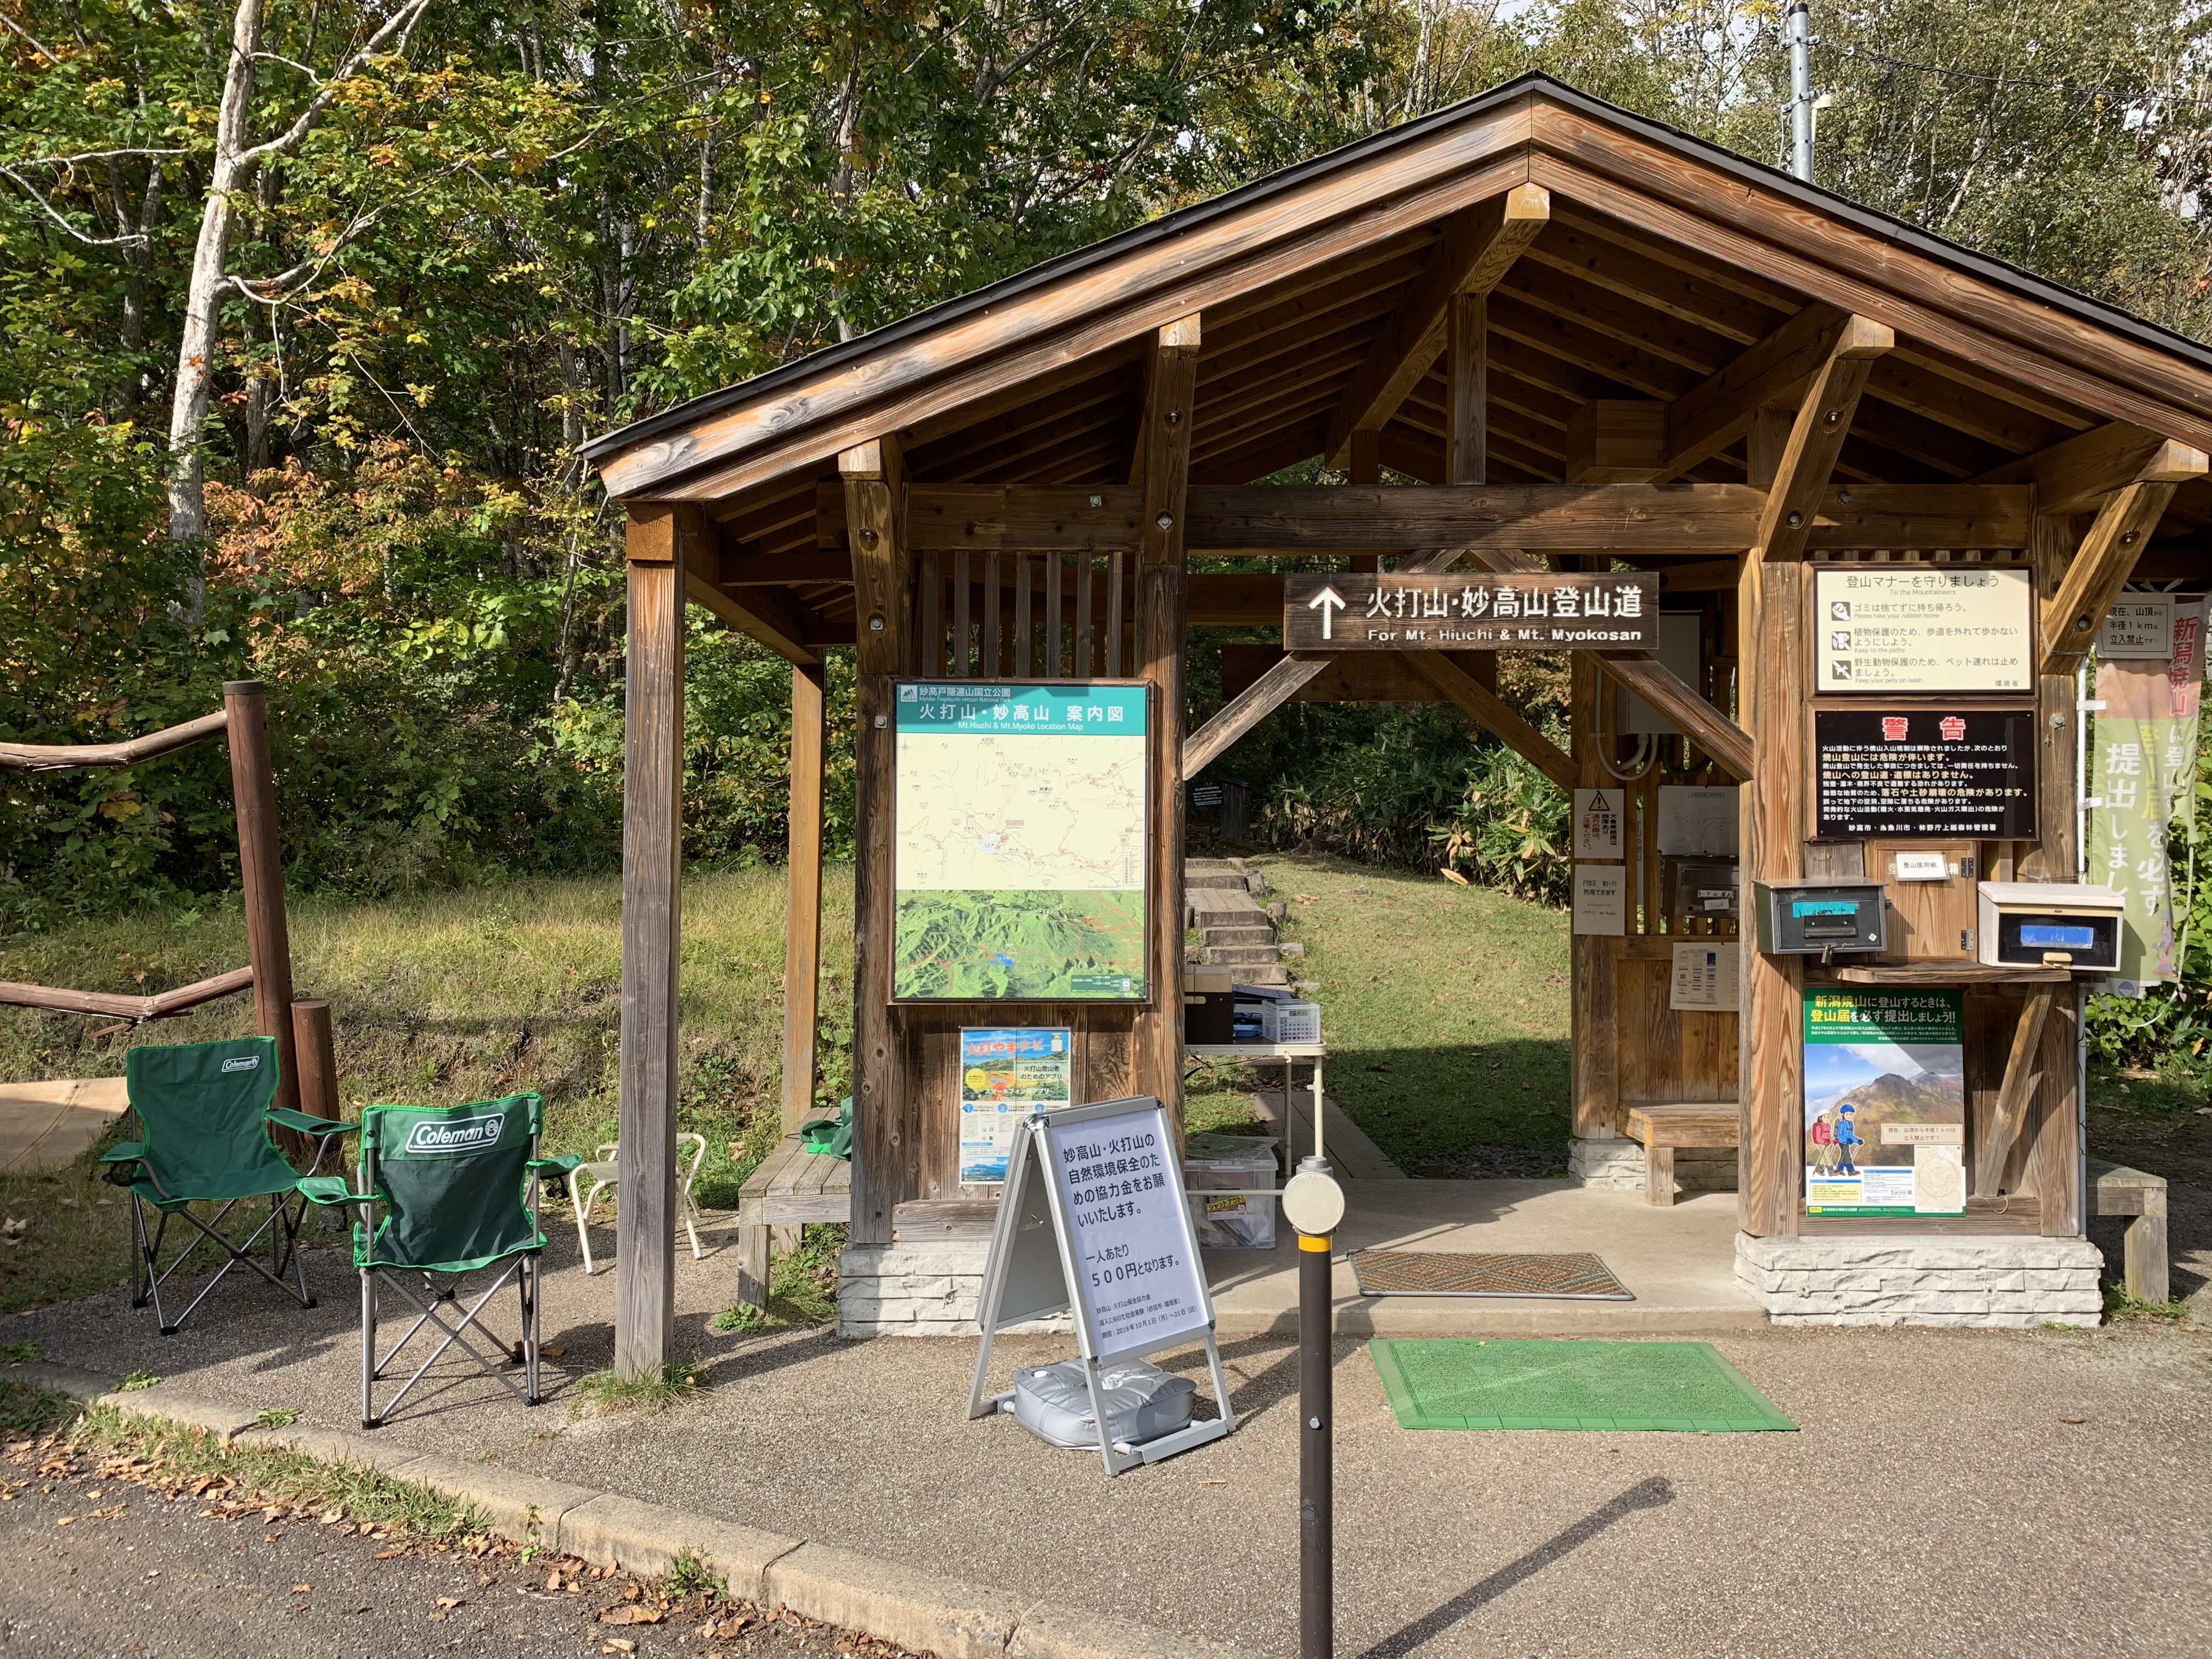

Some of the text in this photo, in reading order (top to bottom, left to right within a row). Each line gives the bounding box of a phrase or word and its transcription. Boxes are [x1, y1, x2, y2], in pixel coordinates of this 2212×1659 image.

[1847, 575, 1999, 588] 登山マナーを守りましょう
[1365, 585, 1642, 618] 火打山・妙高山登山道
[1854, 603, 1967, 612] ゴミは捨てずに持ち帰ろう。
[2109, 607, 2163, 616] 現在、山頂から
[1368, 628, 1641, 642] For Mt. Hiuchi & Mt. Myokosan
[1854, 627, 2018, 636] 植物保護のため、歩道を外れて歩かない
[1854, 638, 1912, 646] ようにしよう。
[1854, 658, 2018, 667] 野生動物保護のため、ペット連れは止め
[1855, 669, 1895, 677] ましょう。
[919, 704, 1124, 723] 火打山・妙高山 案内図
[1001, 723, 1035, 731] Mt.Myoko
[1822, 753, 1950, 761] 焼山登山には危険が伴います。
[1949, 862, 1959, 875] 箱
[1815, 995, 1950, 1008] 新潟焼山に登山するときは、
[225, 1058, 251, 1069] Coleman
[416, 1125, 483, 1145] Coleman
[1063, 1133, 1155, 1163] 妙高山・火打山の
[1068, 1153, 1160, 1184] 自然環境保全のた
[1073, 1172, 1165, 1206] めの協力金をお願
[1077, 1201, 1142, 1227] いいたします。
[1085, 1244, 1129, 1265] 一人あたり
